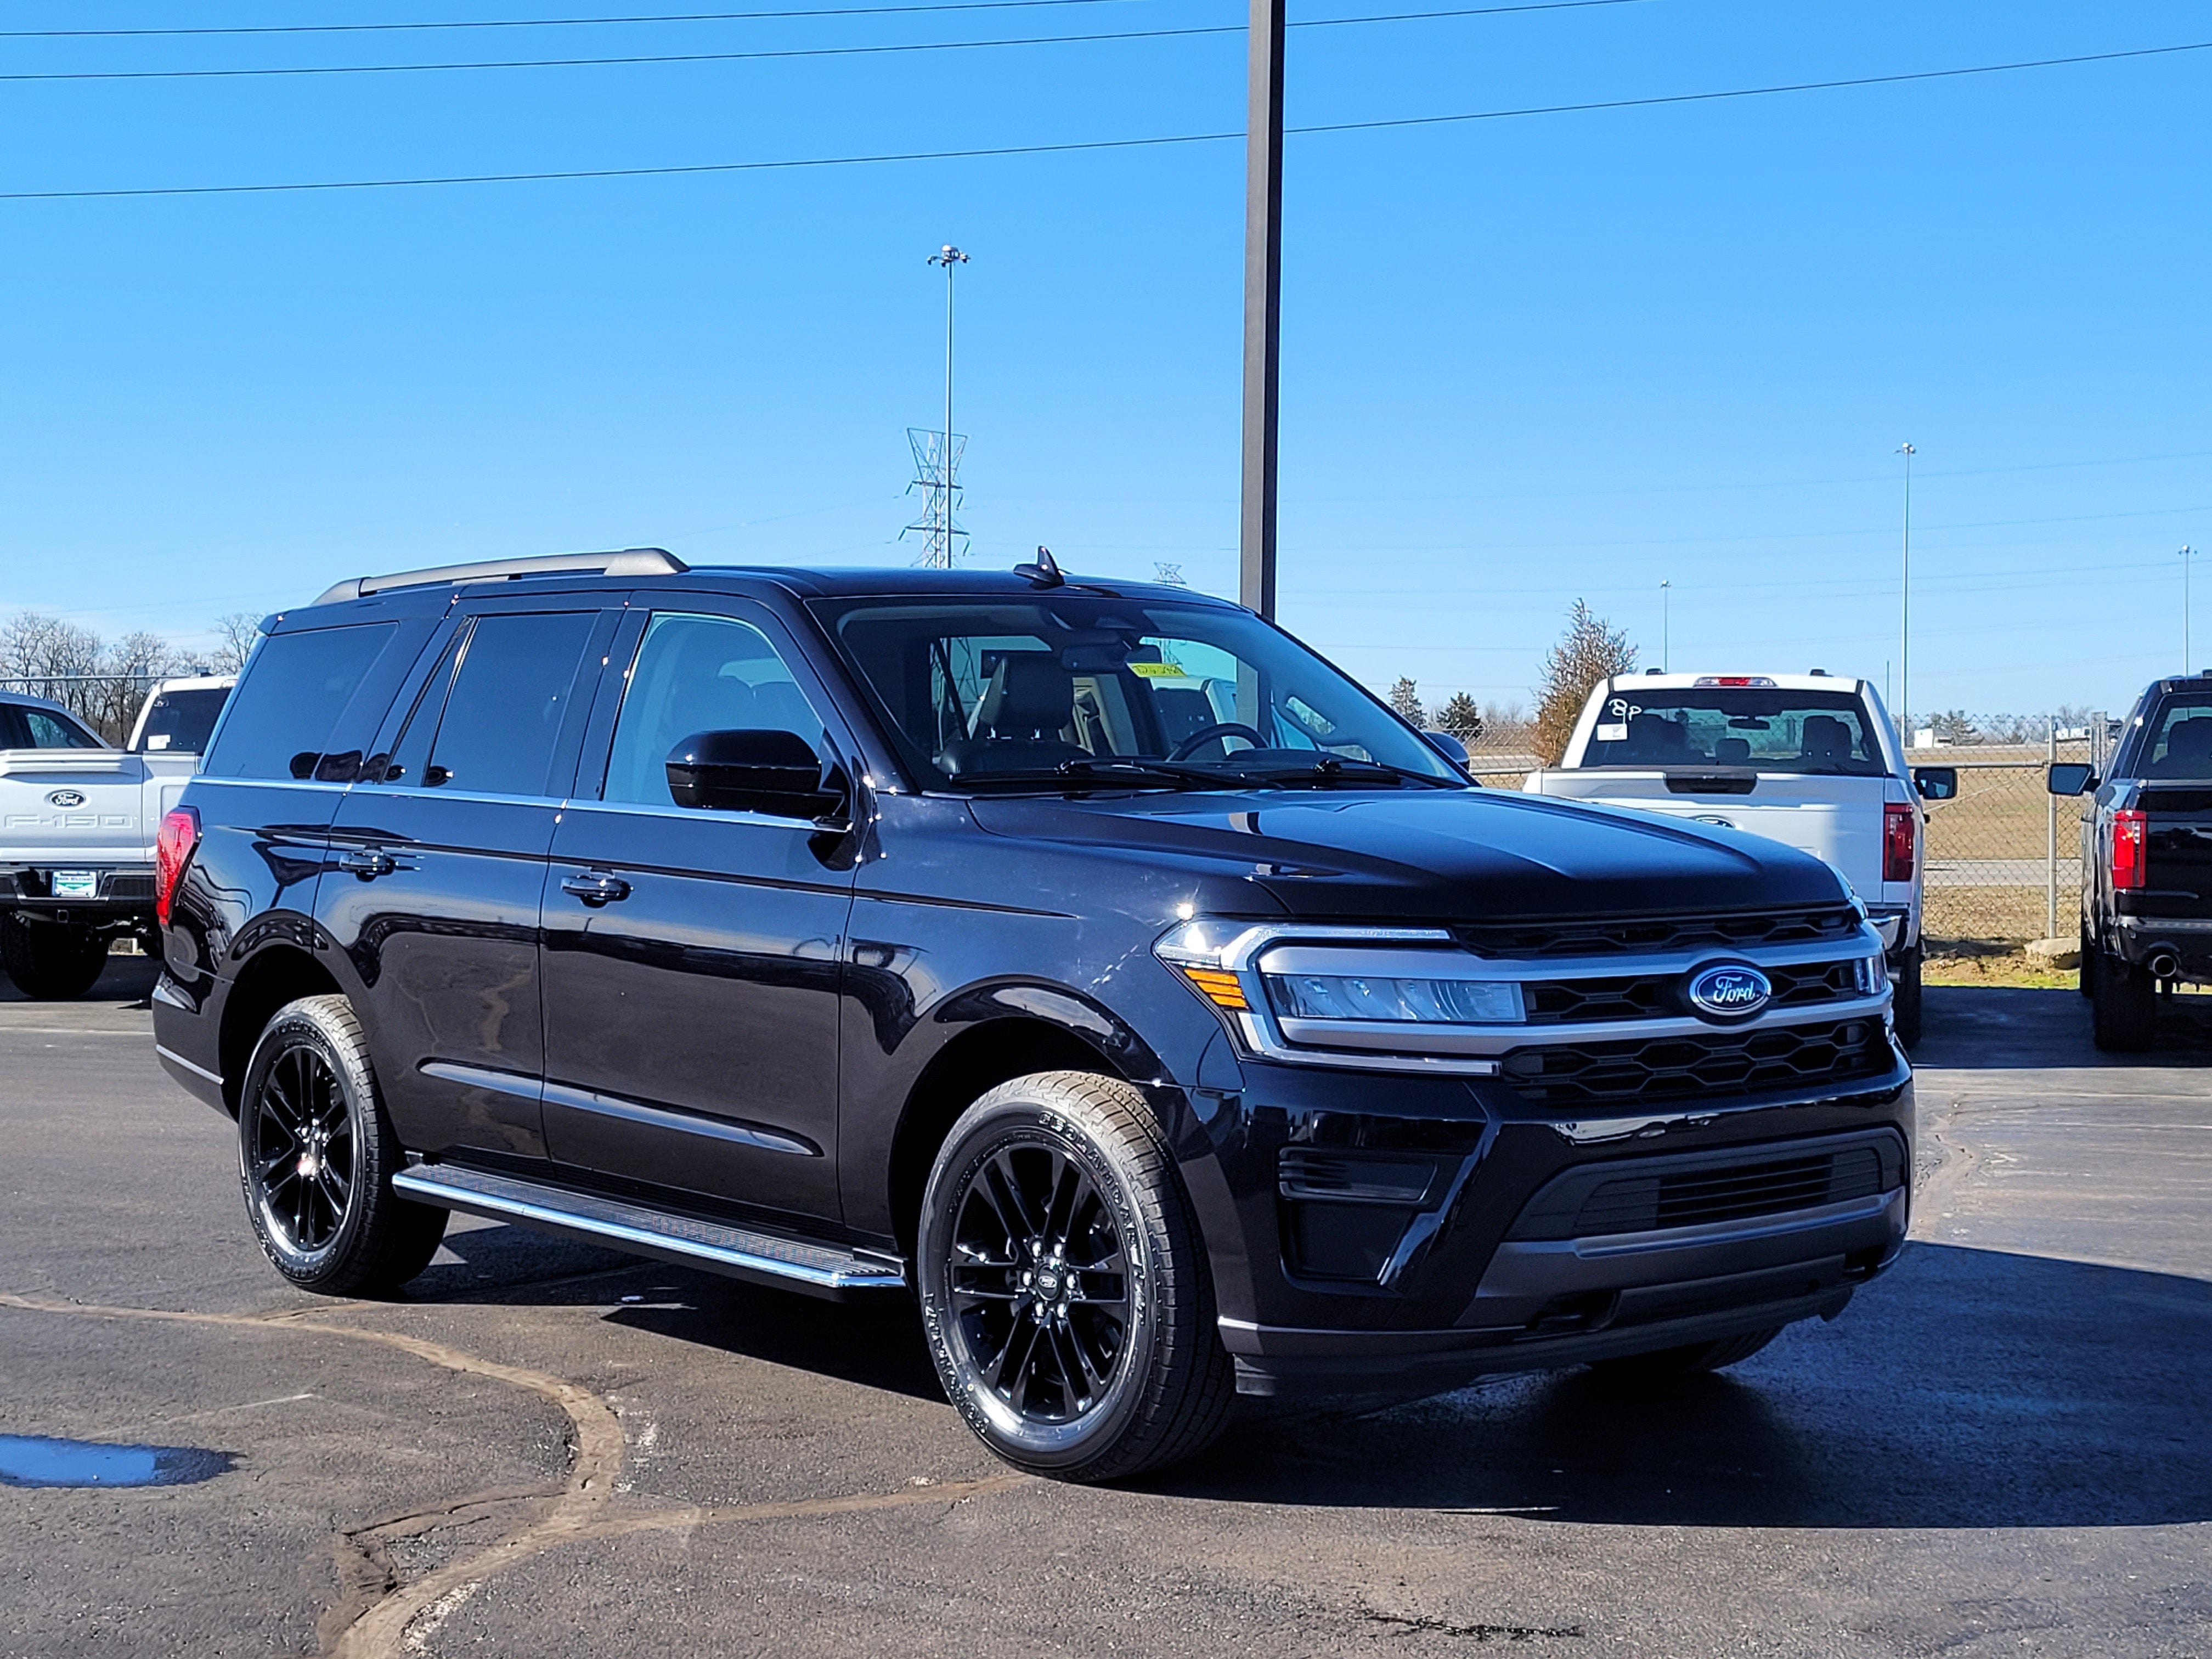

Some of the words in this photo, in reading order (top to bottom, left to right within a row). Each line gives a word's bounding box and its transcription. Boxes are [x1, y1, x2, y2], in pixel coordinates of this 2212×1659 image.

[55, 793, 79, 805] Ford
[4, 814, 133, 828] F-150
[1713, 976, 1756, 1003] Ford
[922, 1293, 990, 1434] YOKOHAMA
